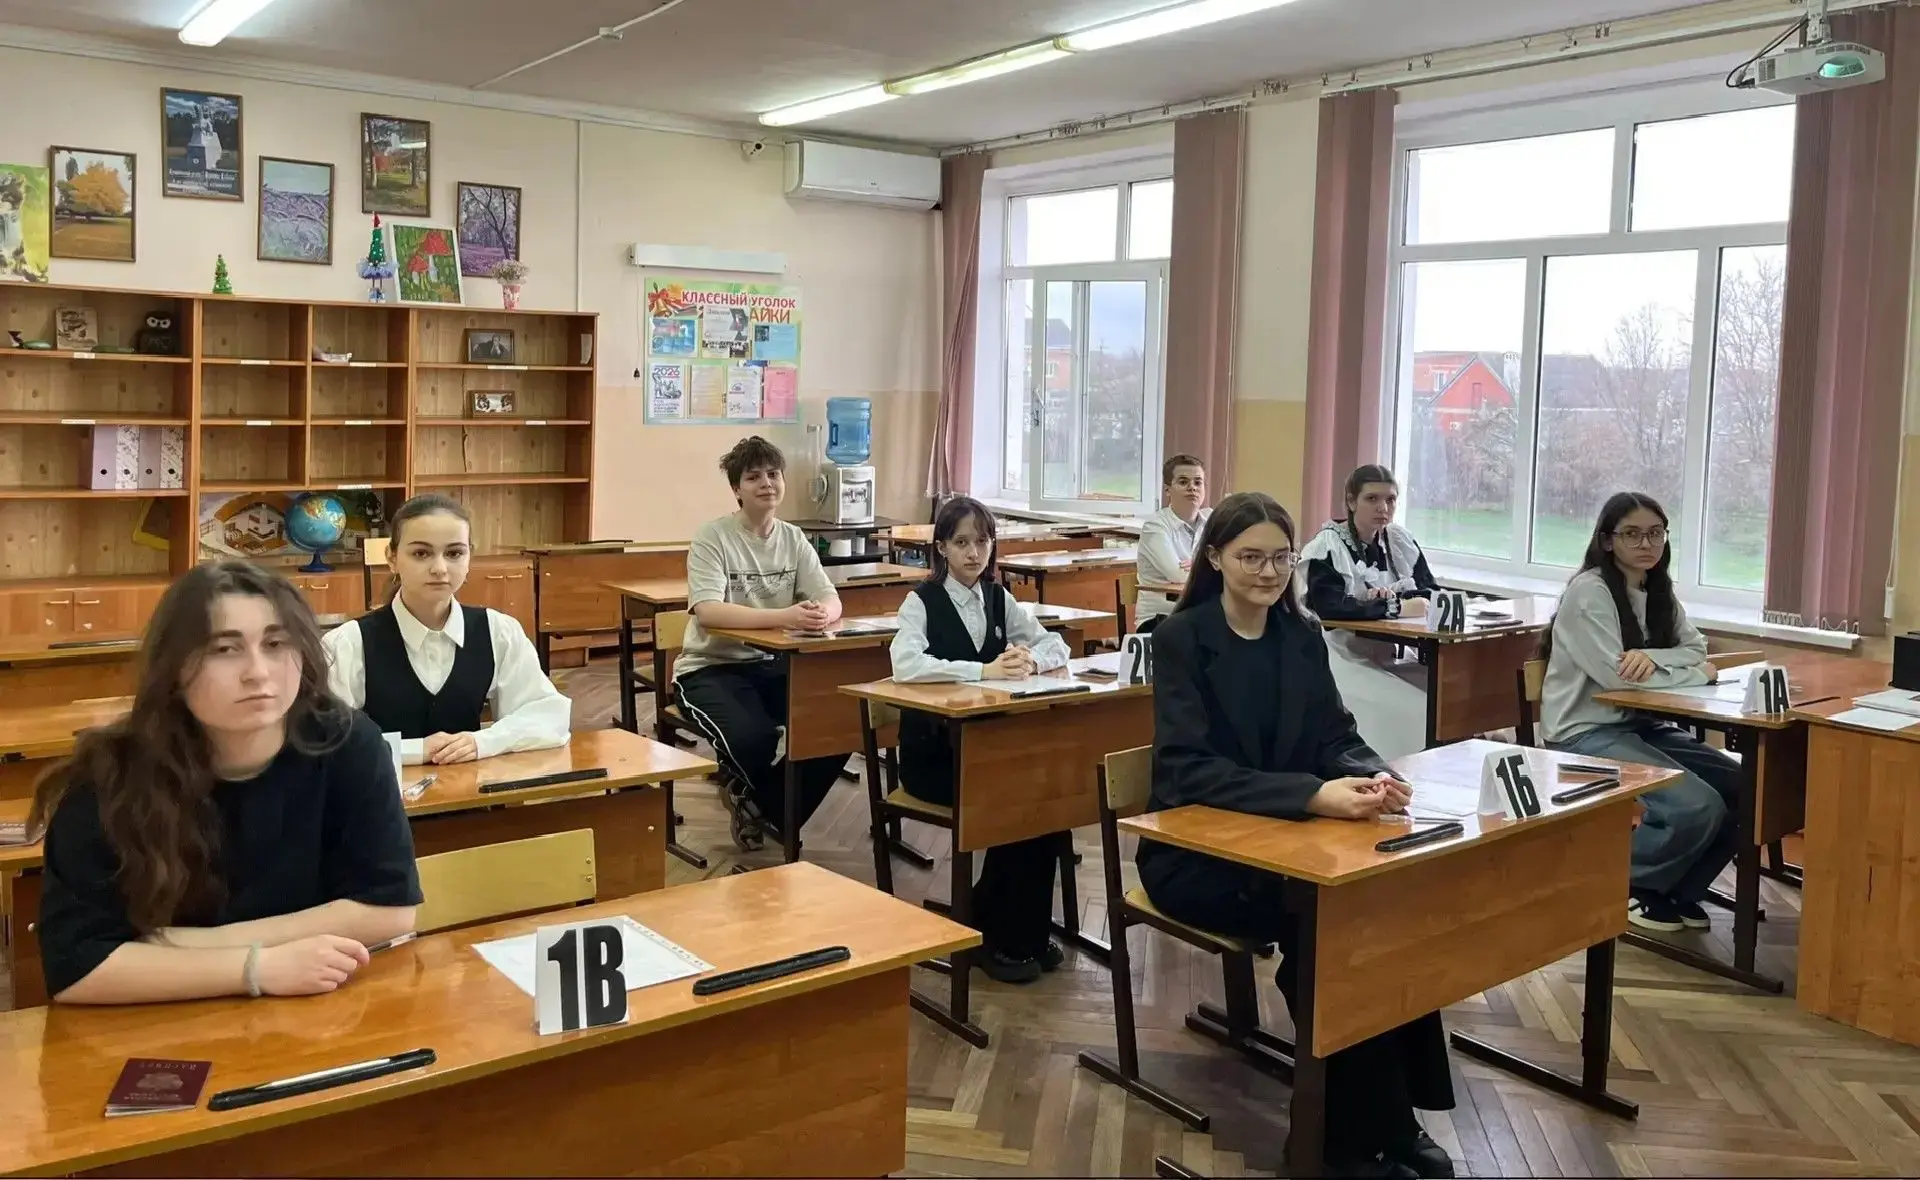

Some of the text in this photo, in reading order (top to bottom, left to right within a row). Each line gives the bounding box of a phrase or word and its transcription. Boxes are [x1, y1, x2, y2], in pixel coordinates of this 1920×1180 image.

[682, 291, 796, 309] КЛАССНЫЙ УГОЛОК
[654, 367, 680, 376] 2026
[1437, 593, 1465, 632] 2А
[1759, 669, 1790, 713] 1А
[1496, 754, 1541, 818] 1Б
[547, 925, 628, 1031] 1В
